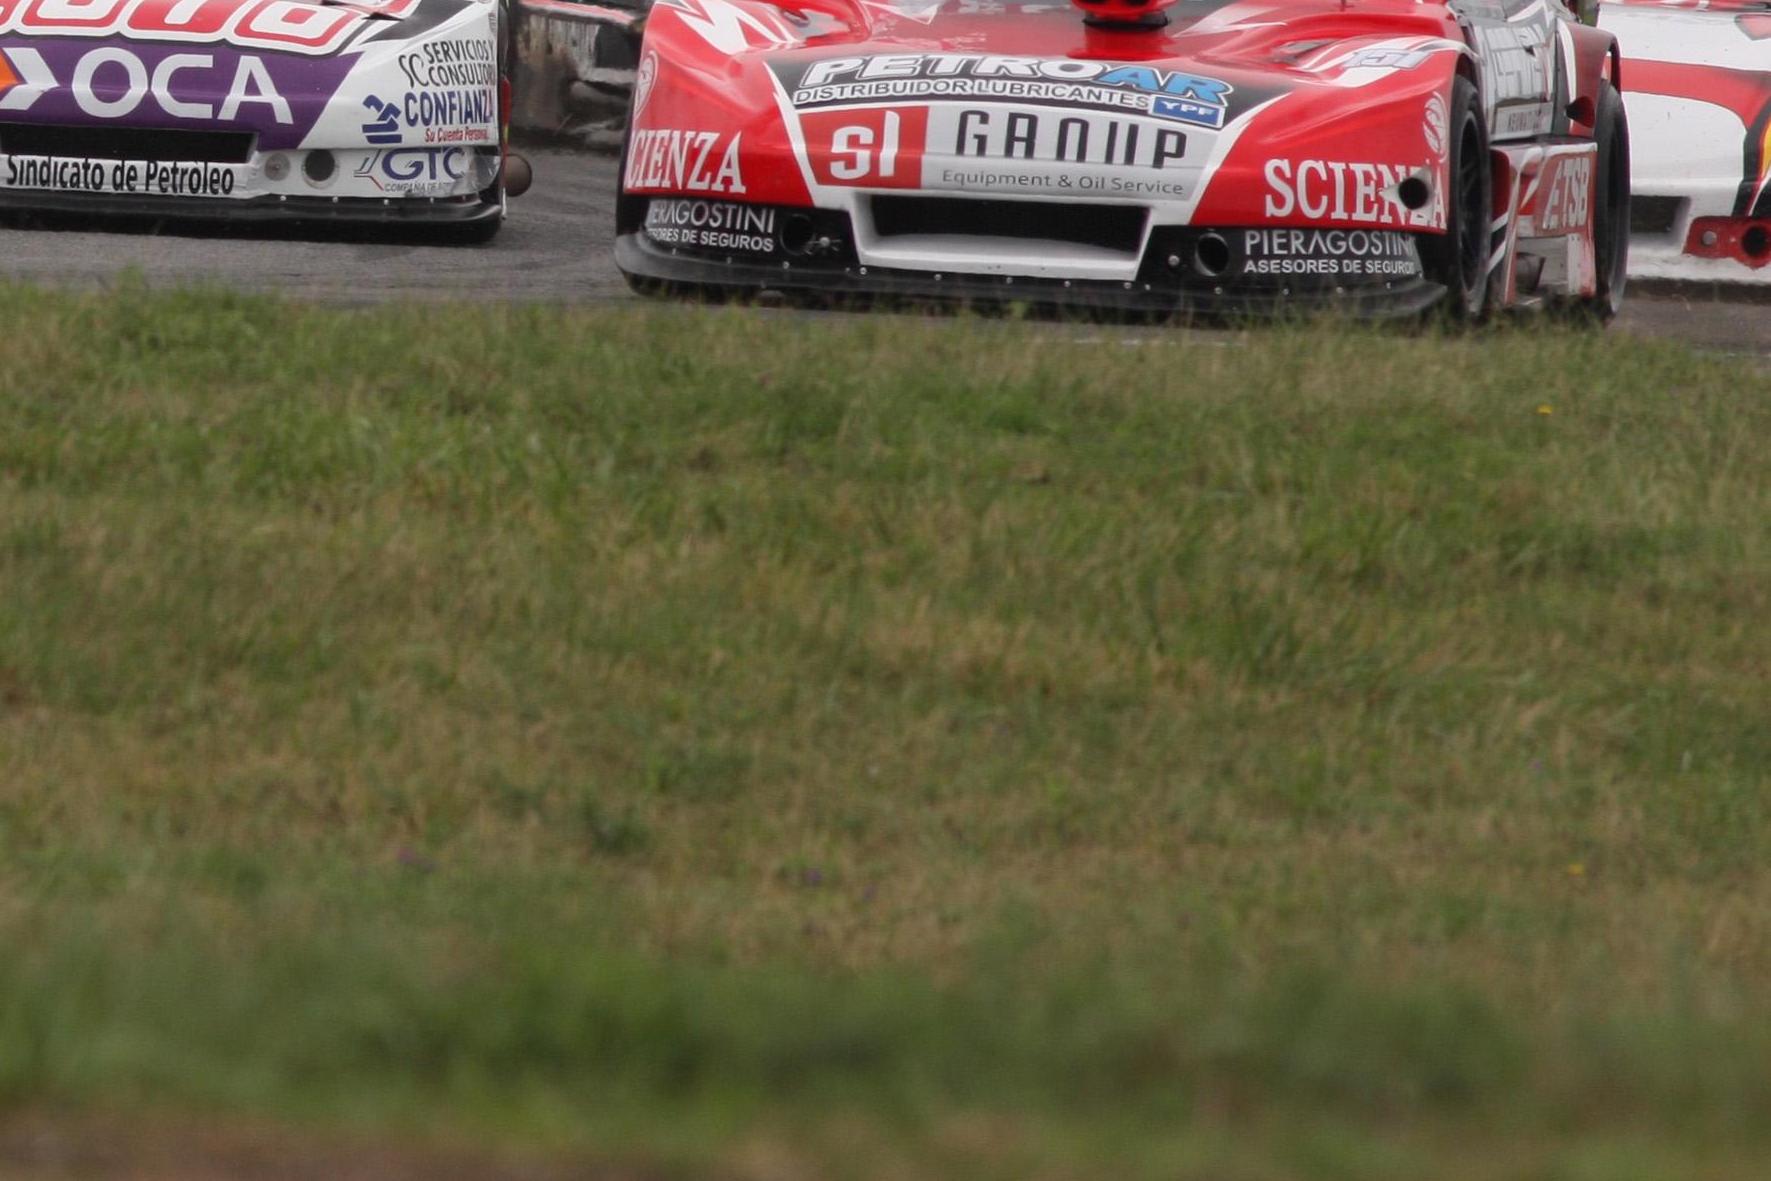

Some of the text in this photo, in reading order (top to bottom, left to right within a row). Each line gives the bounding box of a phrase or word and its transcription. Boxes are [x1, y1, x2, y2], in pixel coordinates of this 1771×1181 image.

[423, 39, 489, 65] SERVICIOS
[71, 46, 294, 125] OCA
[792, 78, 1152, 110] DISTRIBUIDOR LUBRICANTES
[800, 54, 1235, 106] PETROAR
[1162, 99, 1216, 118] YPF
[6, 154, 105, 191] Sindicato
[112, 159, 139, 193] de
[381, 147, 467, 181] GTC
[941, 169, 1184, 196] Equipment & Oil Service
[681, 228, 698, 244] DE
[700, 231, 775, 253] SEGUROS
[1243, 259, 1339, 275] ASESORES
[1342, 260, 1362, 274] DE
